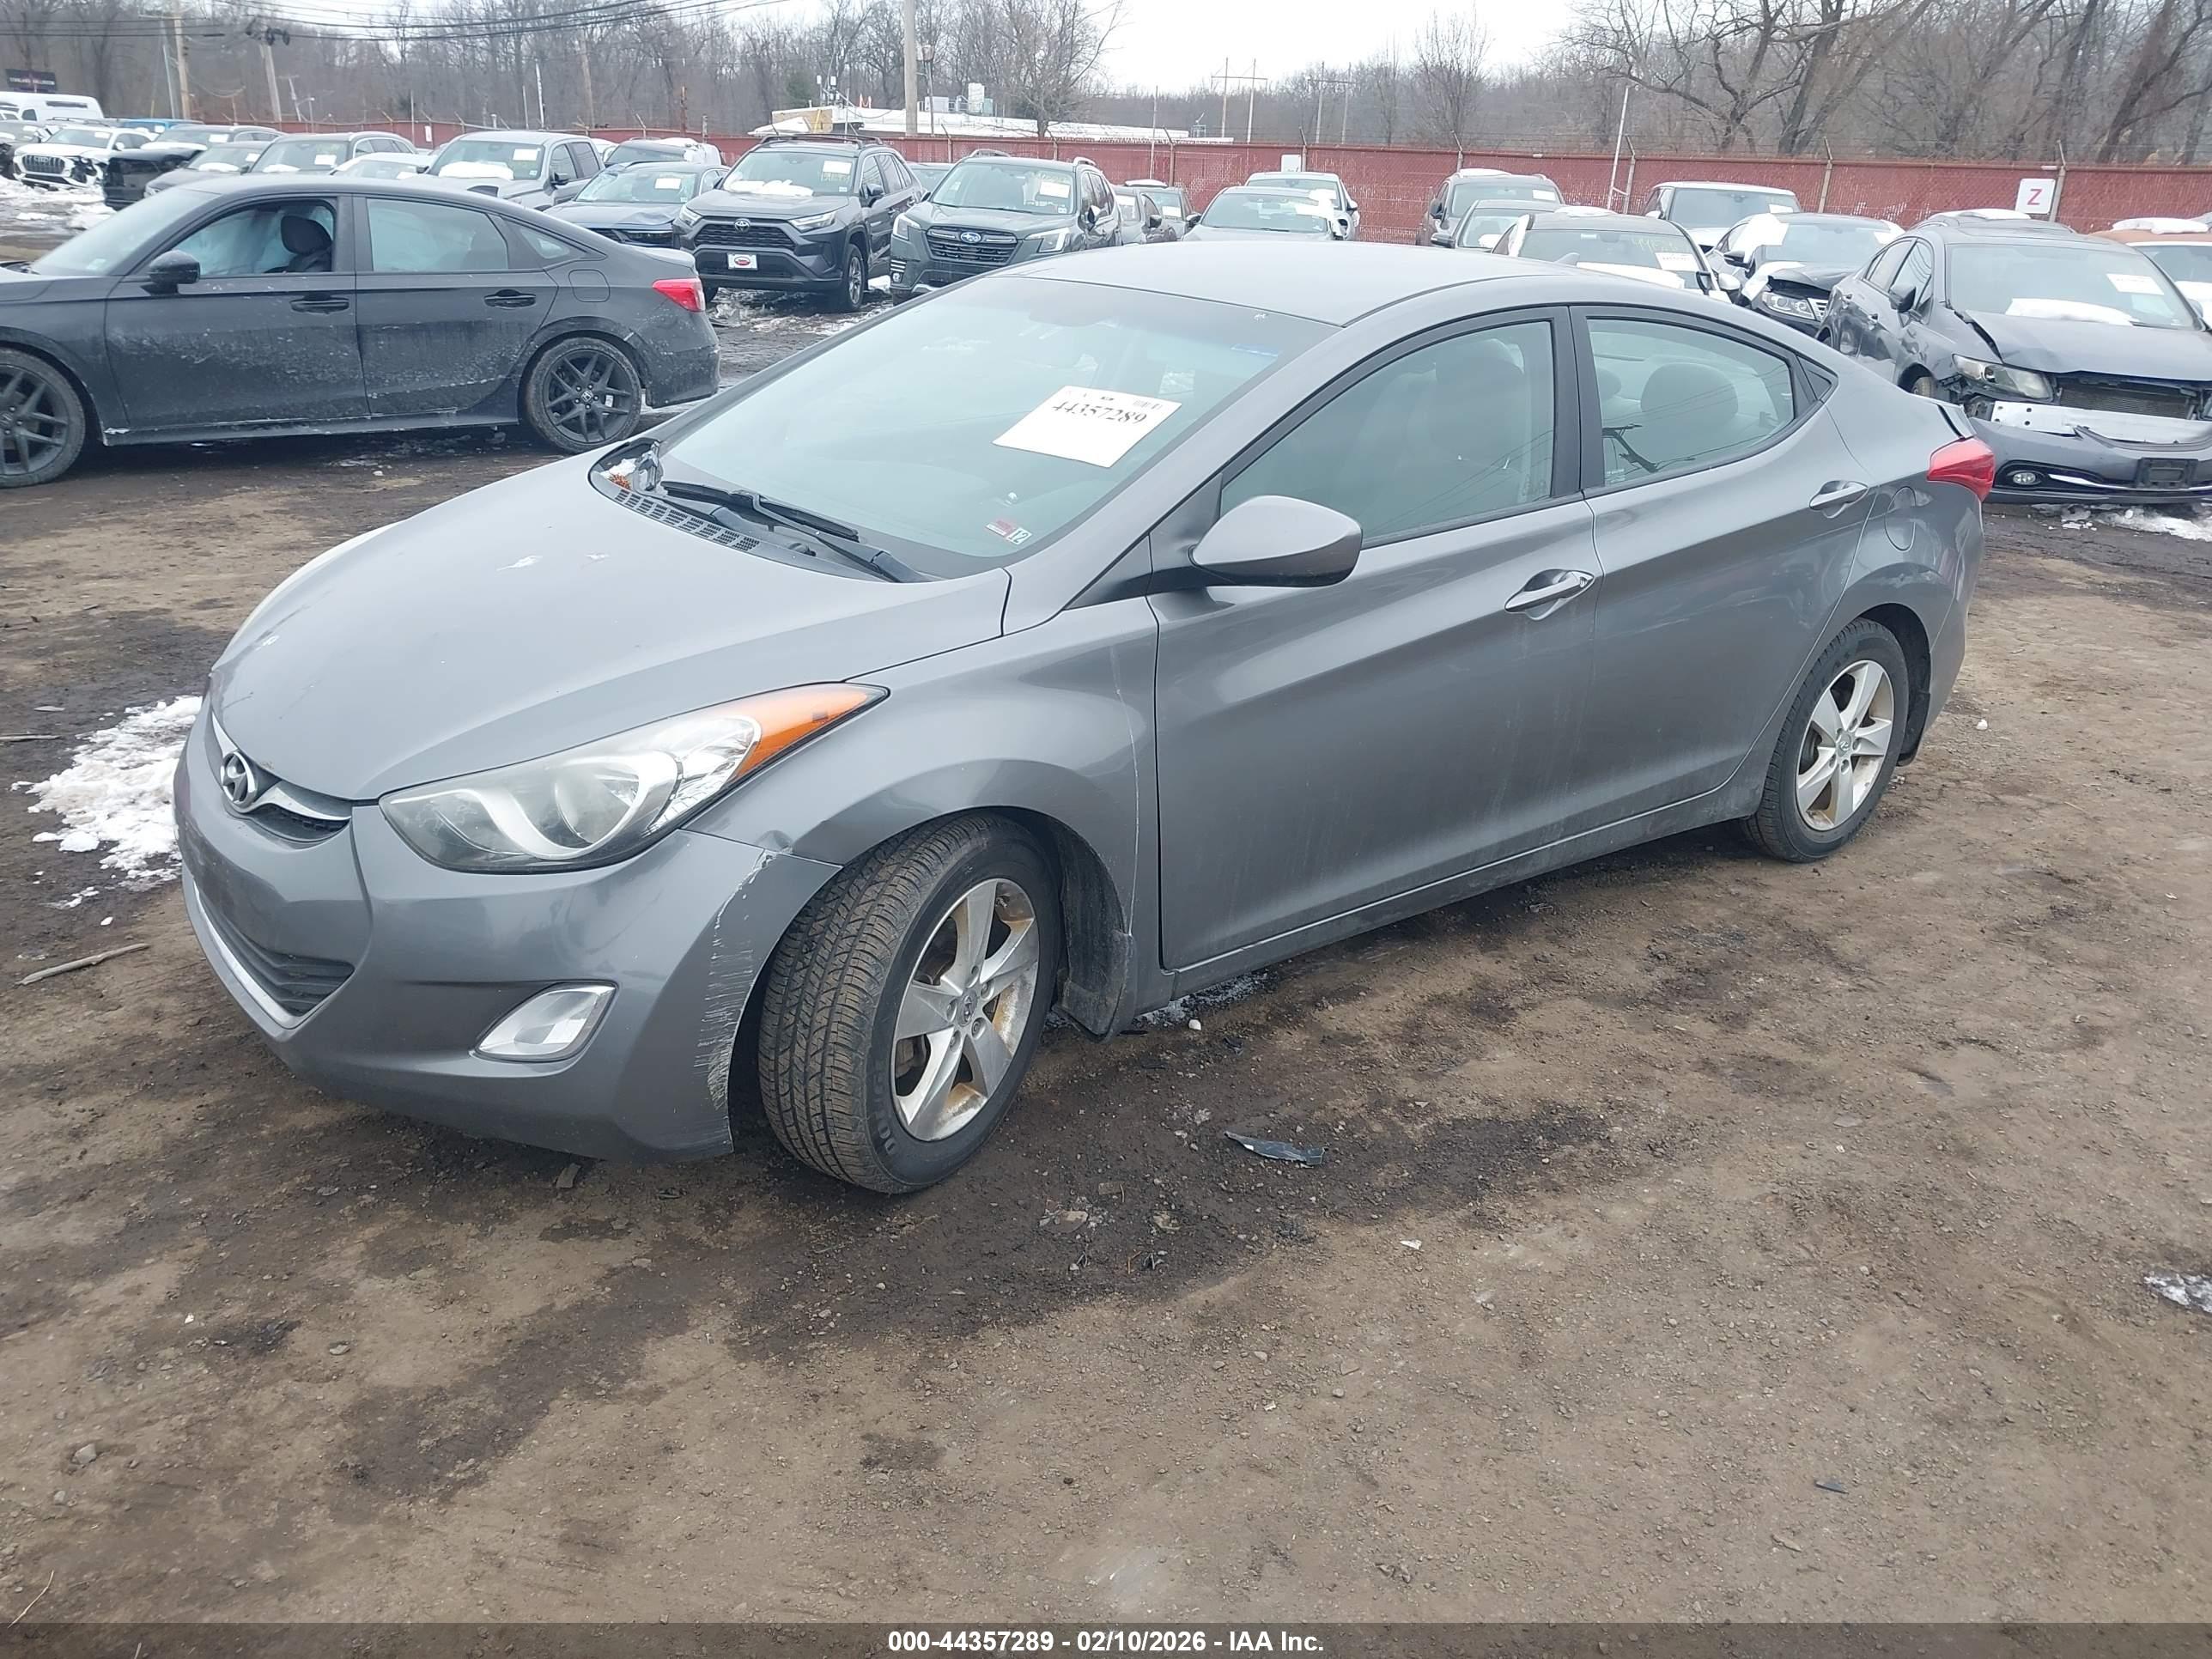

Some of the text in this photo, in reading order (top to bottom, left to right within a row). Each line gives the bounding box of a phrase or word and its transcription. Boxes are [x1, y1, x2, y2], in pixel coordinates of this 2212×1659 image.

[2027, 188, 2044, 205] Z
[1051, 401, 1147, 424] 44357289
[1008, 530, 1029, 544] 12
